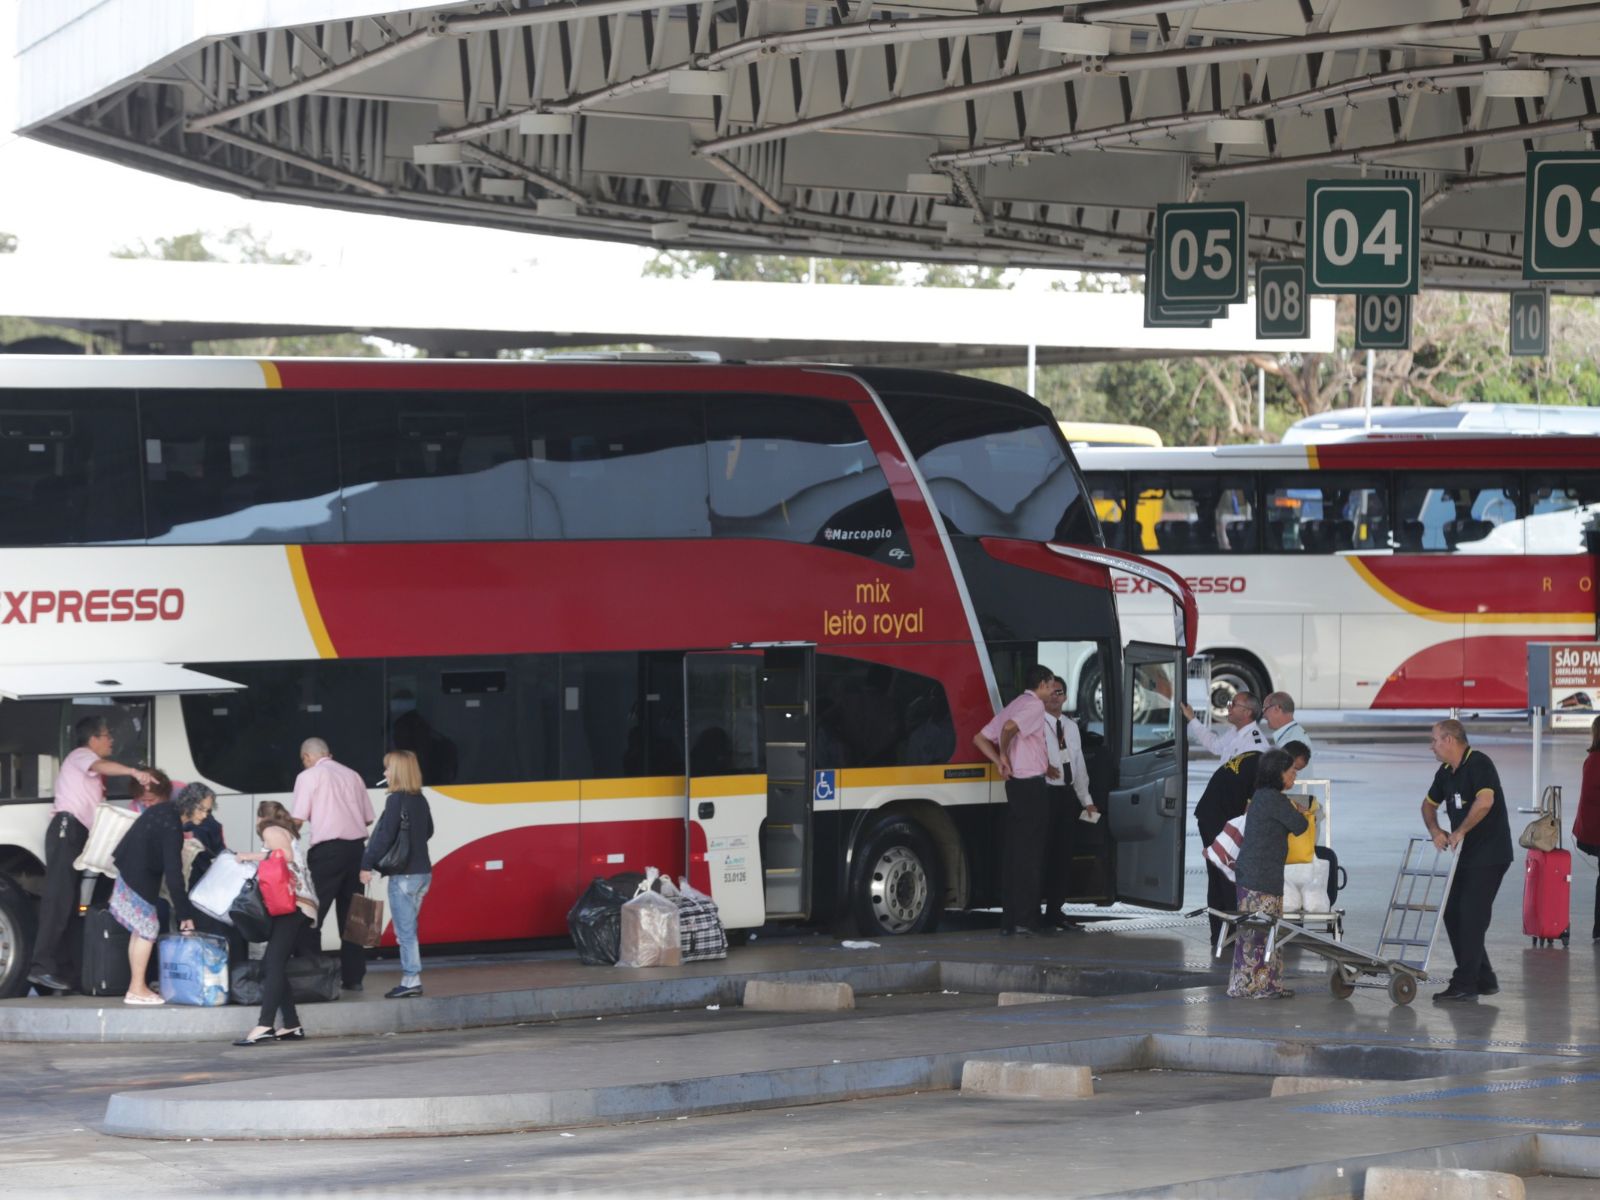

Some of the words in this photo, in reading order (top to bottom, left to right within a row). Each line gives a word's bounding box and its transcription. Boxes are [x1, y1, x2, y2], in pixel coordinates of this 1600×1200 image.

[1169, 228, 1233, 281] 05
[1322, 208, 1402, 267] 04
[1262, 280, 1301, 321] 08
[1363, 295, 1402, 333] 09
[1515, 303, 1541, 341] 10
[832, 528, 892, 540] Marcopolo
[856, 578, 891, 603] mix
[1114, 576, 1247, 594] EXESSO
[0, 588, 185, 625] XPRESSO
[824, 609, 867, 636] leito
[873, 607, 923, 639] royal
[1555, 648, 1580, 667] SÃO
[1582, 650, 1600, 667] PA
